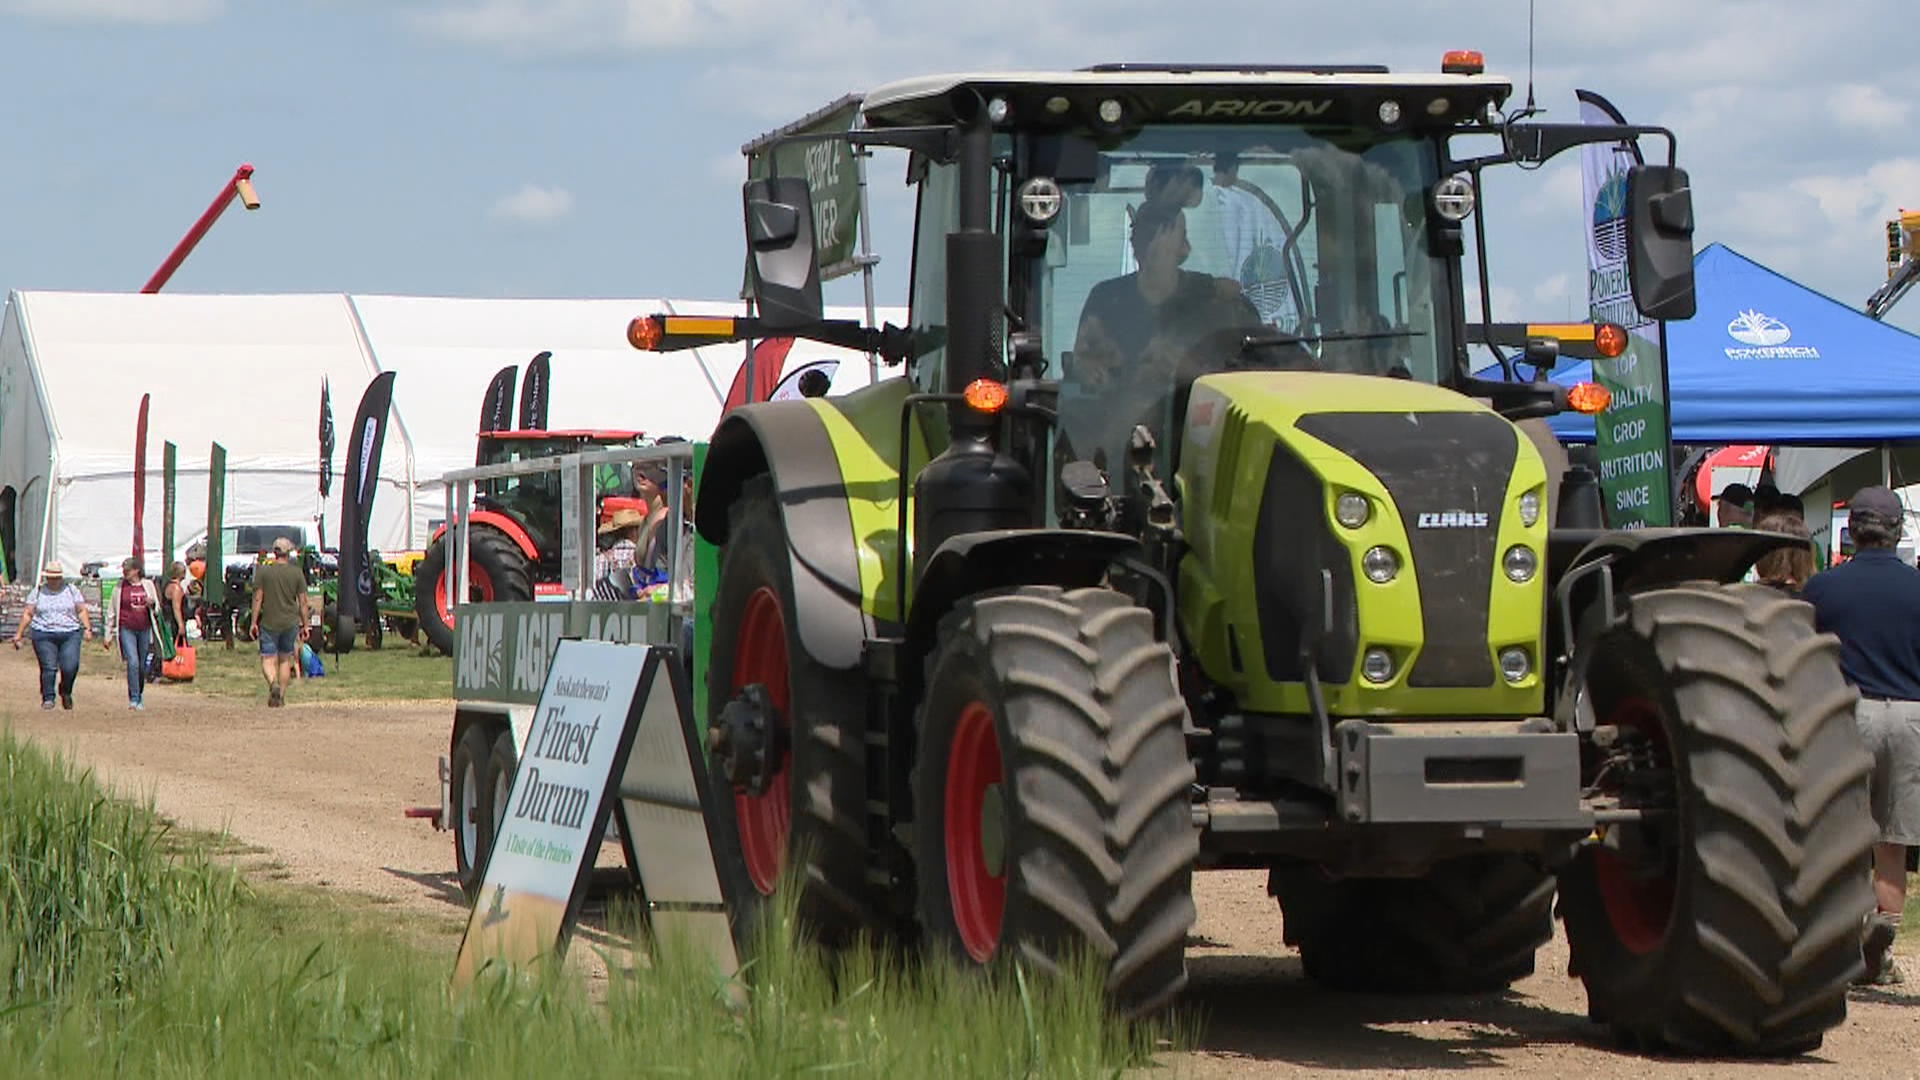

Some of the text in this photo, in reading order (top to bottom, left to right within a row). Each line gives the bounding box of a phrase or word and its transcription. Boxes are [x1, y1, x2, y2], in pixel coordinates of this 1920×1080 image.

[1167, 99, 1334, 116] ARION
[804, 139, 841, 192] PEOPLE
[1614, 353, 1638, 376] TOP
[1613, 418, 1646, 443] CROP
[1600, 448, 1664, 480] NUTRITION
[1616, 485, 1649, 511] SINCE
[1417, 512, 1489, 528] CLAAS
[458, 613, 488, 690] AGI
[513, 613, 548, 691] AGI
[553, 675, 611, 702] Saskatchewan's
[534, 705, 601, 765] Finest
[515, 767, 590, 830] Durum
[545, 841, 573, 864] Prairies
